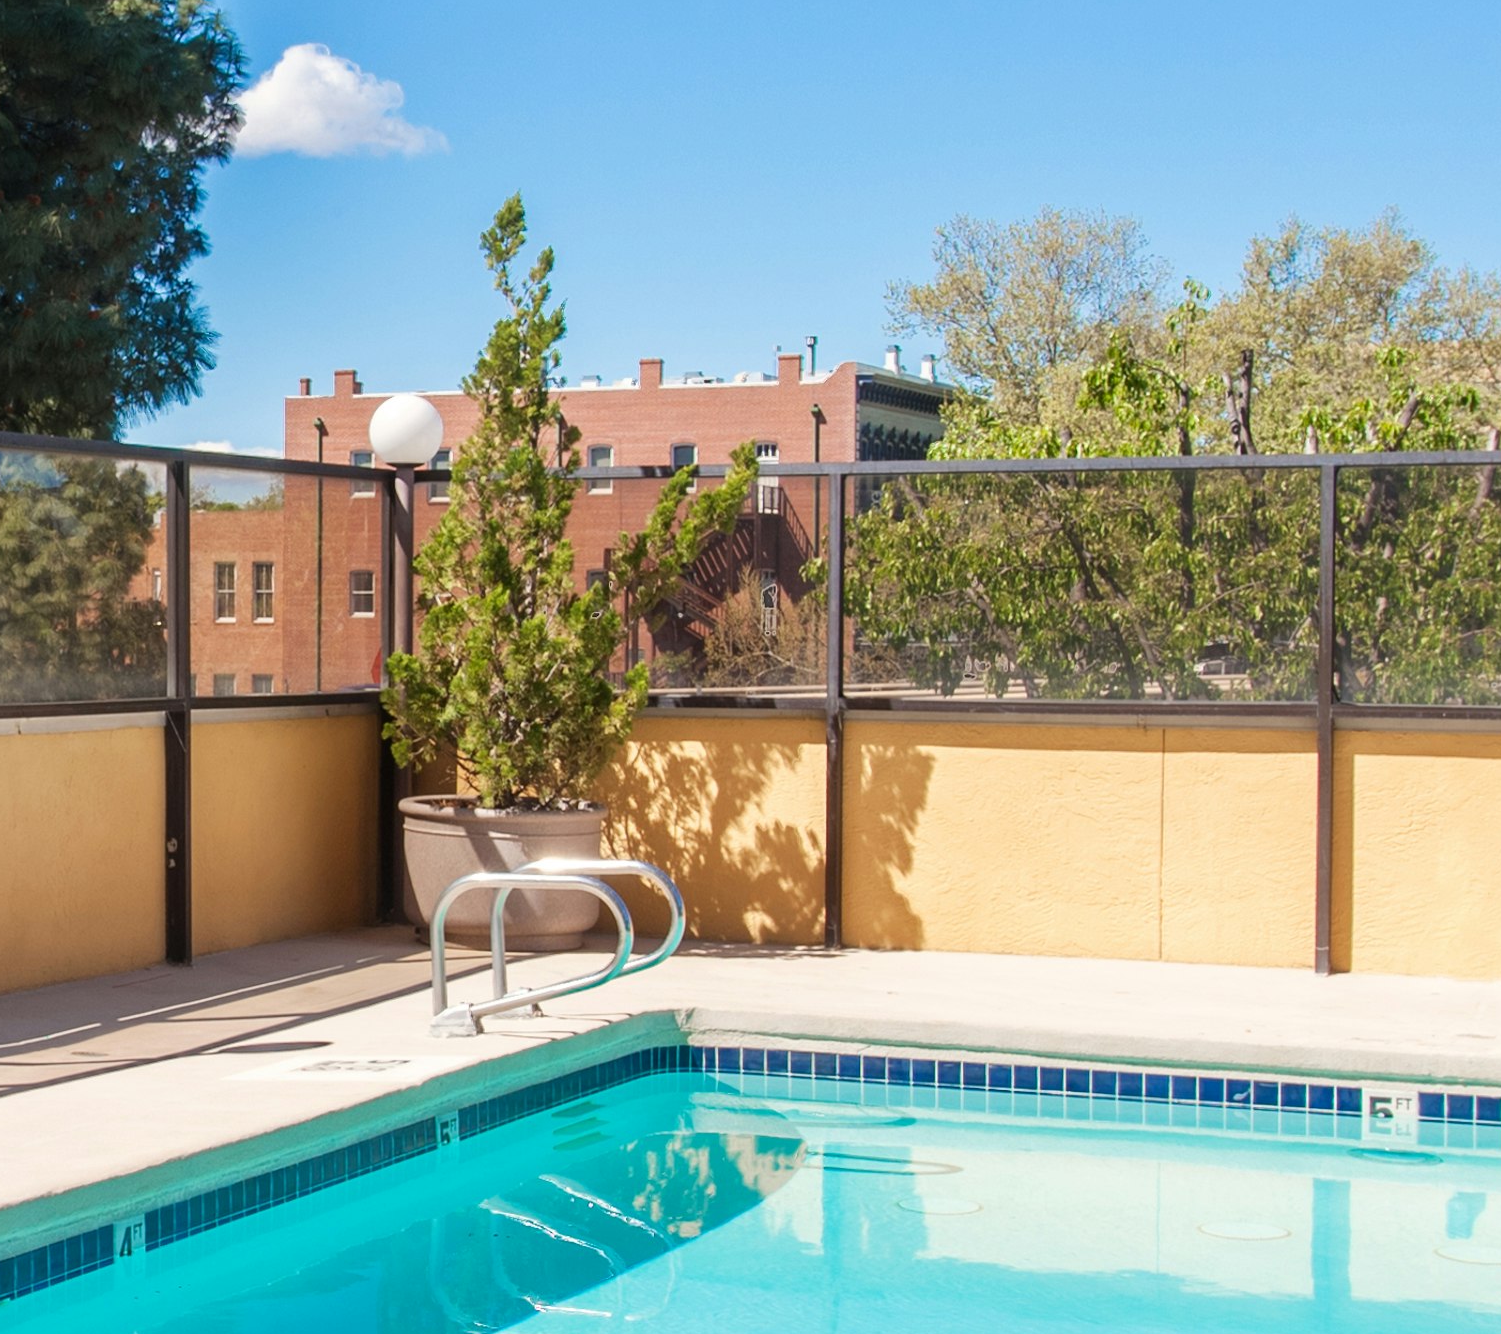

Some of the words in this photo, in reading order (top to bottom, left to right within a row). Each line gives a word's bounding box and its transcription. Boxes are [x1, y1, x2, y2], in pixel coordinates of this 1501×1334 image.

[1369, 1096, 1393, 1118] 5
[1396, 1097, 1412, 1111] FT
[440, 1120, 450, 1146] 5
[119, 1226, 132, 1257] 4
[133, 1222, 143, 1240] FT
